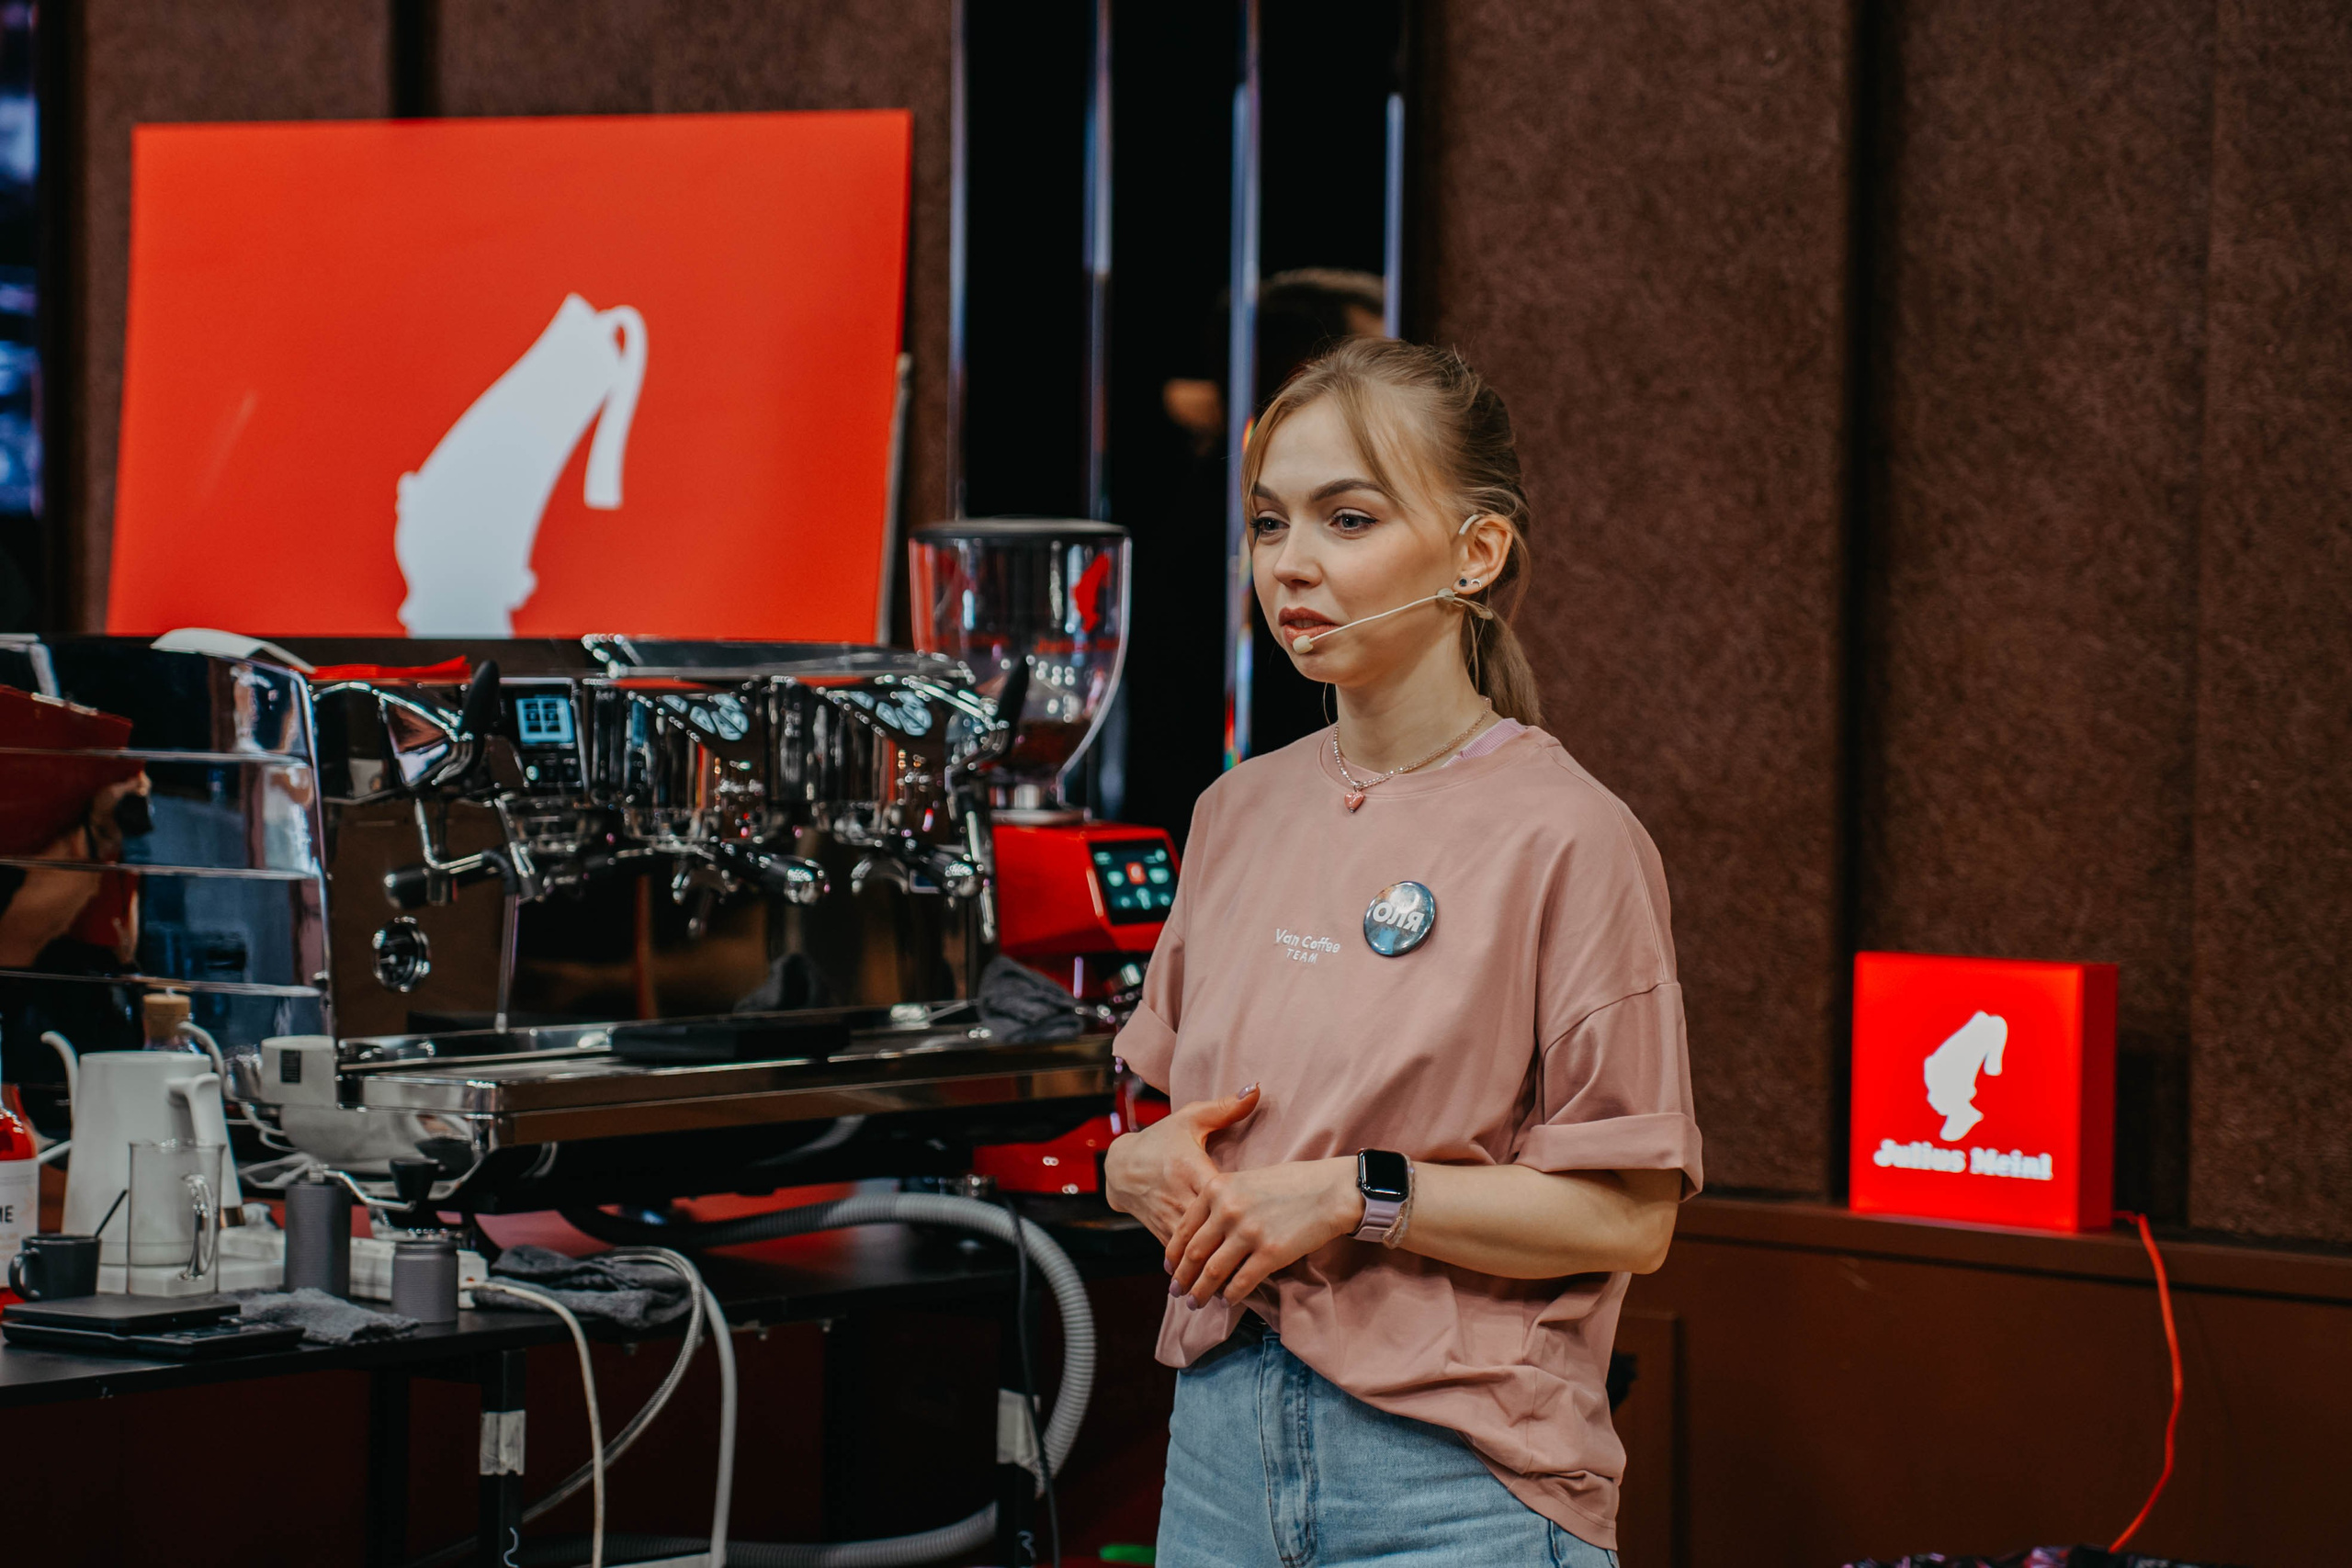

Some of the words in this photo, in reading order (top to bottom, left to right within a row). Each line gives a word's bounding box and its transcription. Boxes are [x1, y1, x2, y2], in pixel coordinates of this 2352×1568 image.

[1275, 928, 1299, 946] Van
[1302, 935, 1340, 953] Coffee
[1286, 948, 1318, 963] TEAM
[1873, 1139, 1966, 1173] Julius
